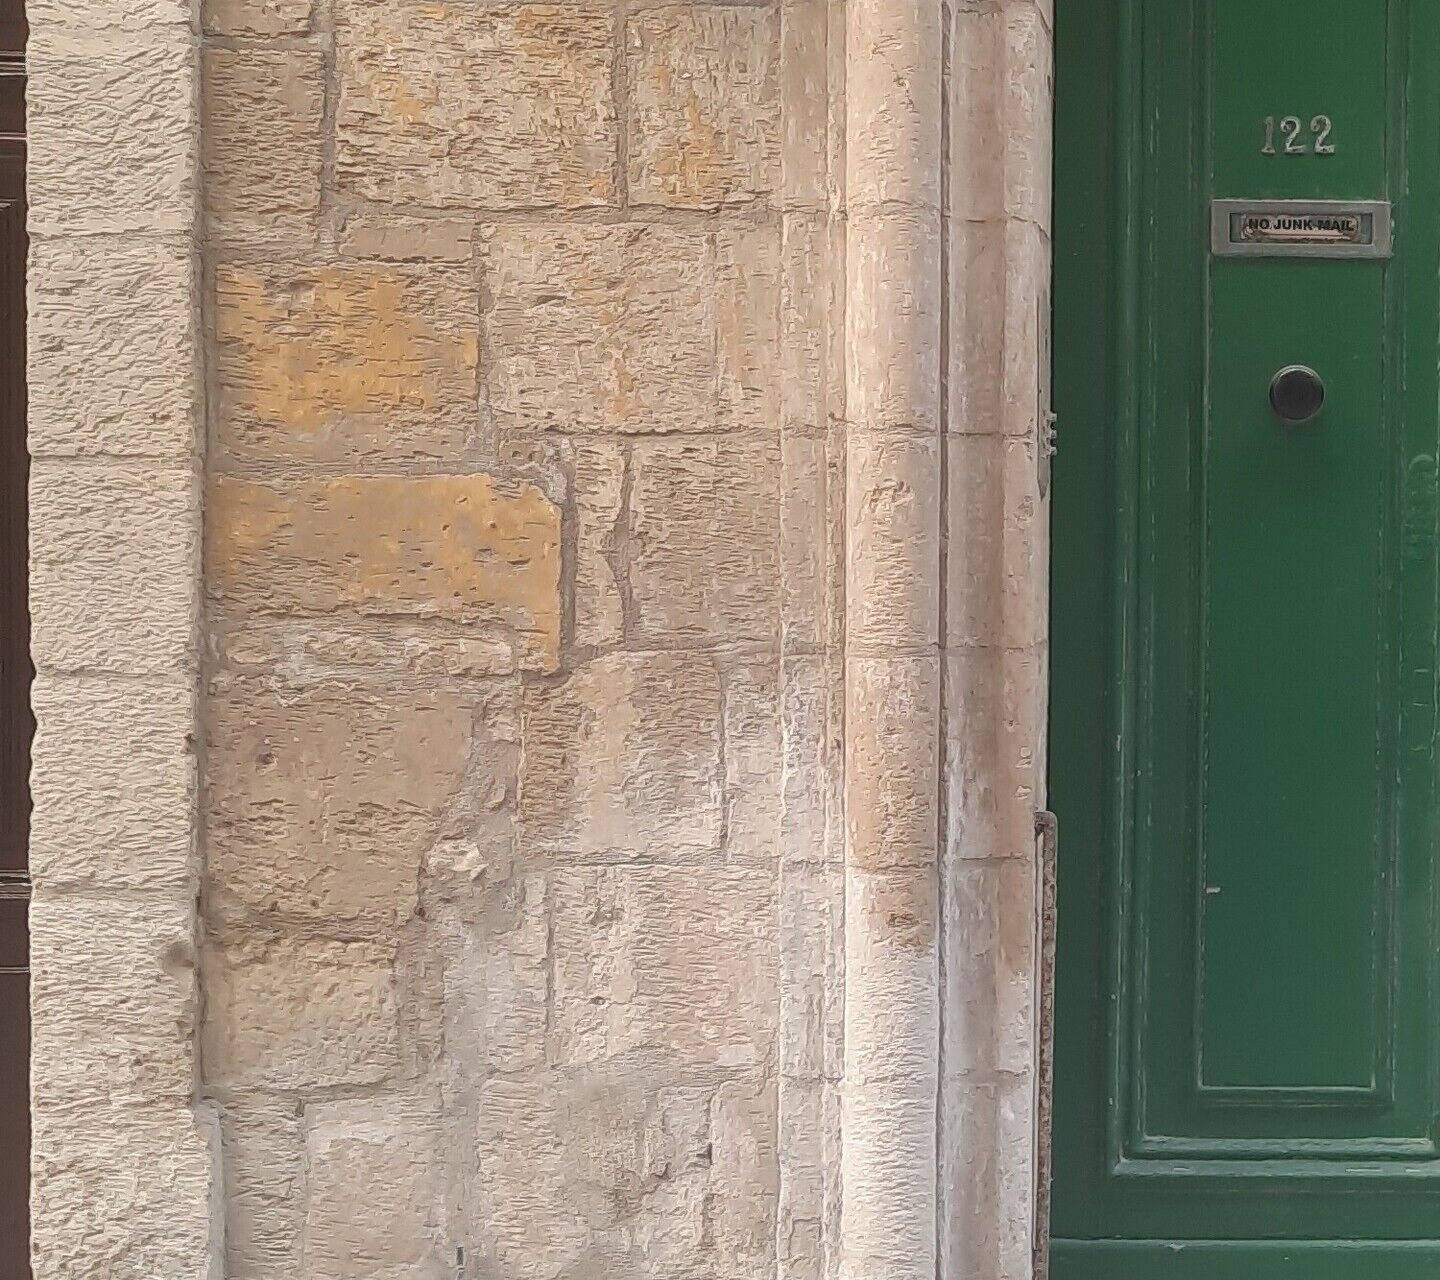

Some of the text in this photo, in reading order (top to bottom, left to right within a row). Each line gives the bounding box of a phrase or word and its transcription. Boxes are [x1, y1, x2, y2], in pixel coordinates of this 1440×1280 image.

[1261, 114, 1336, 154] 122
[1249, 218, 1355, 231] NO JUNK MAIL
